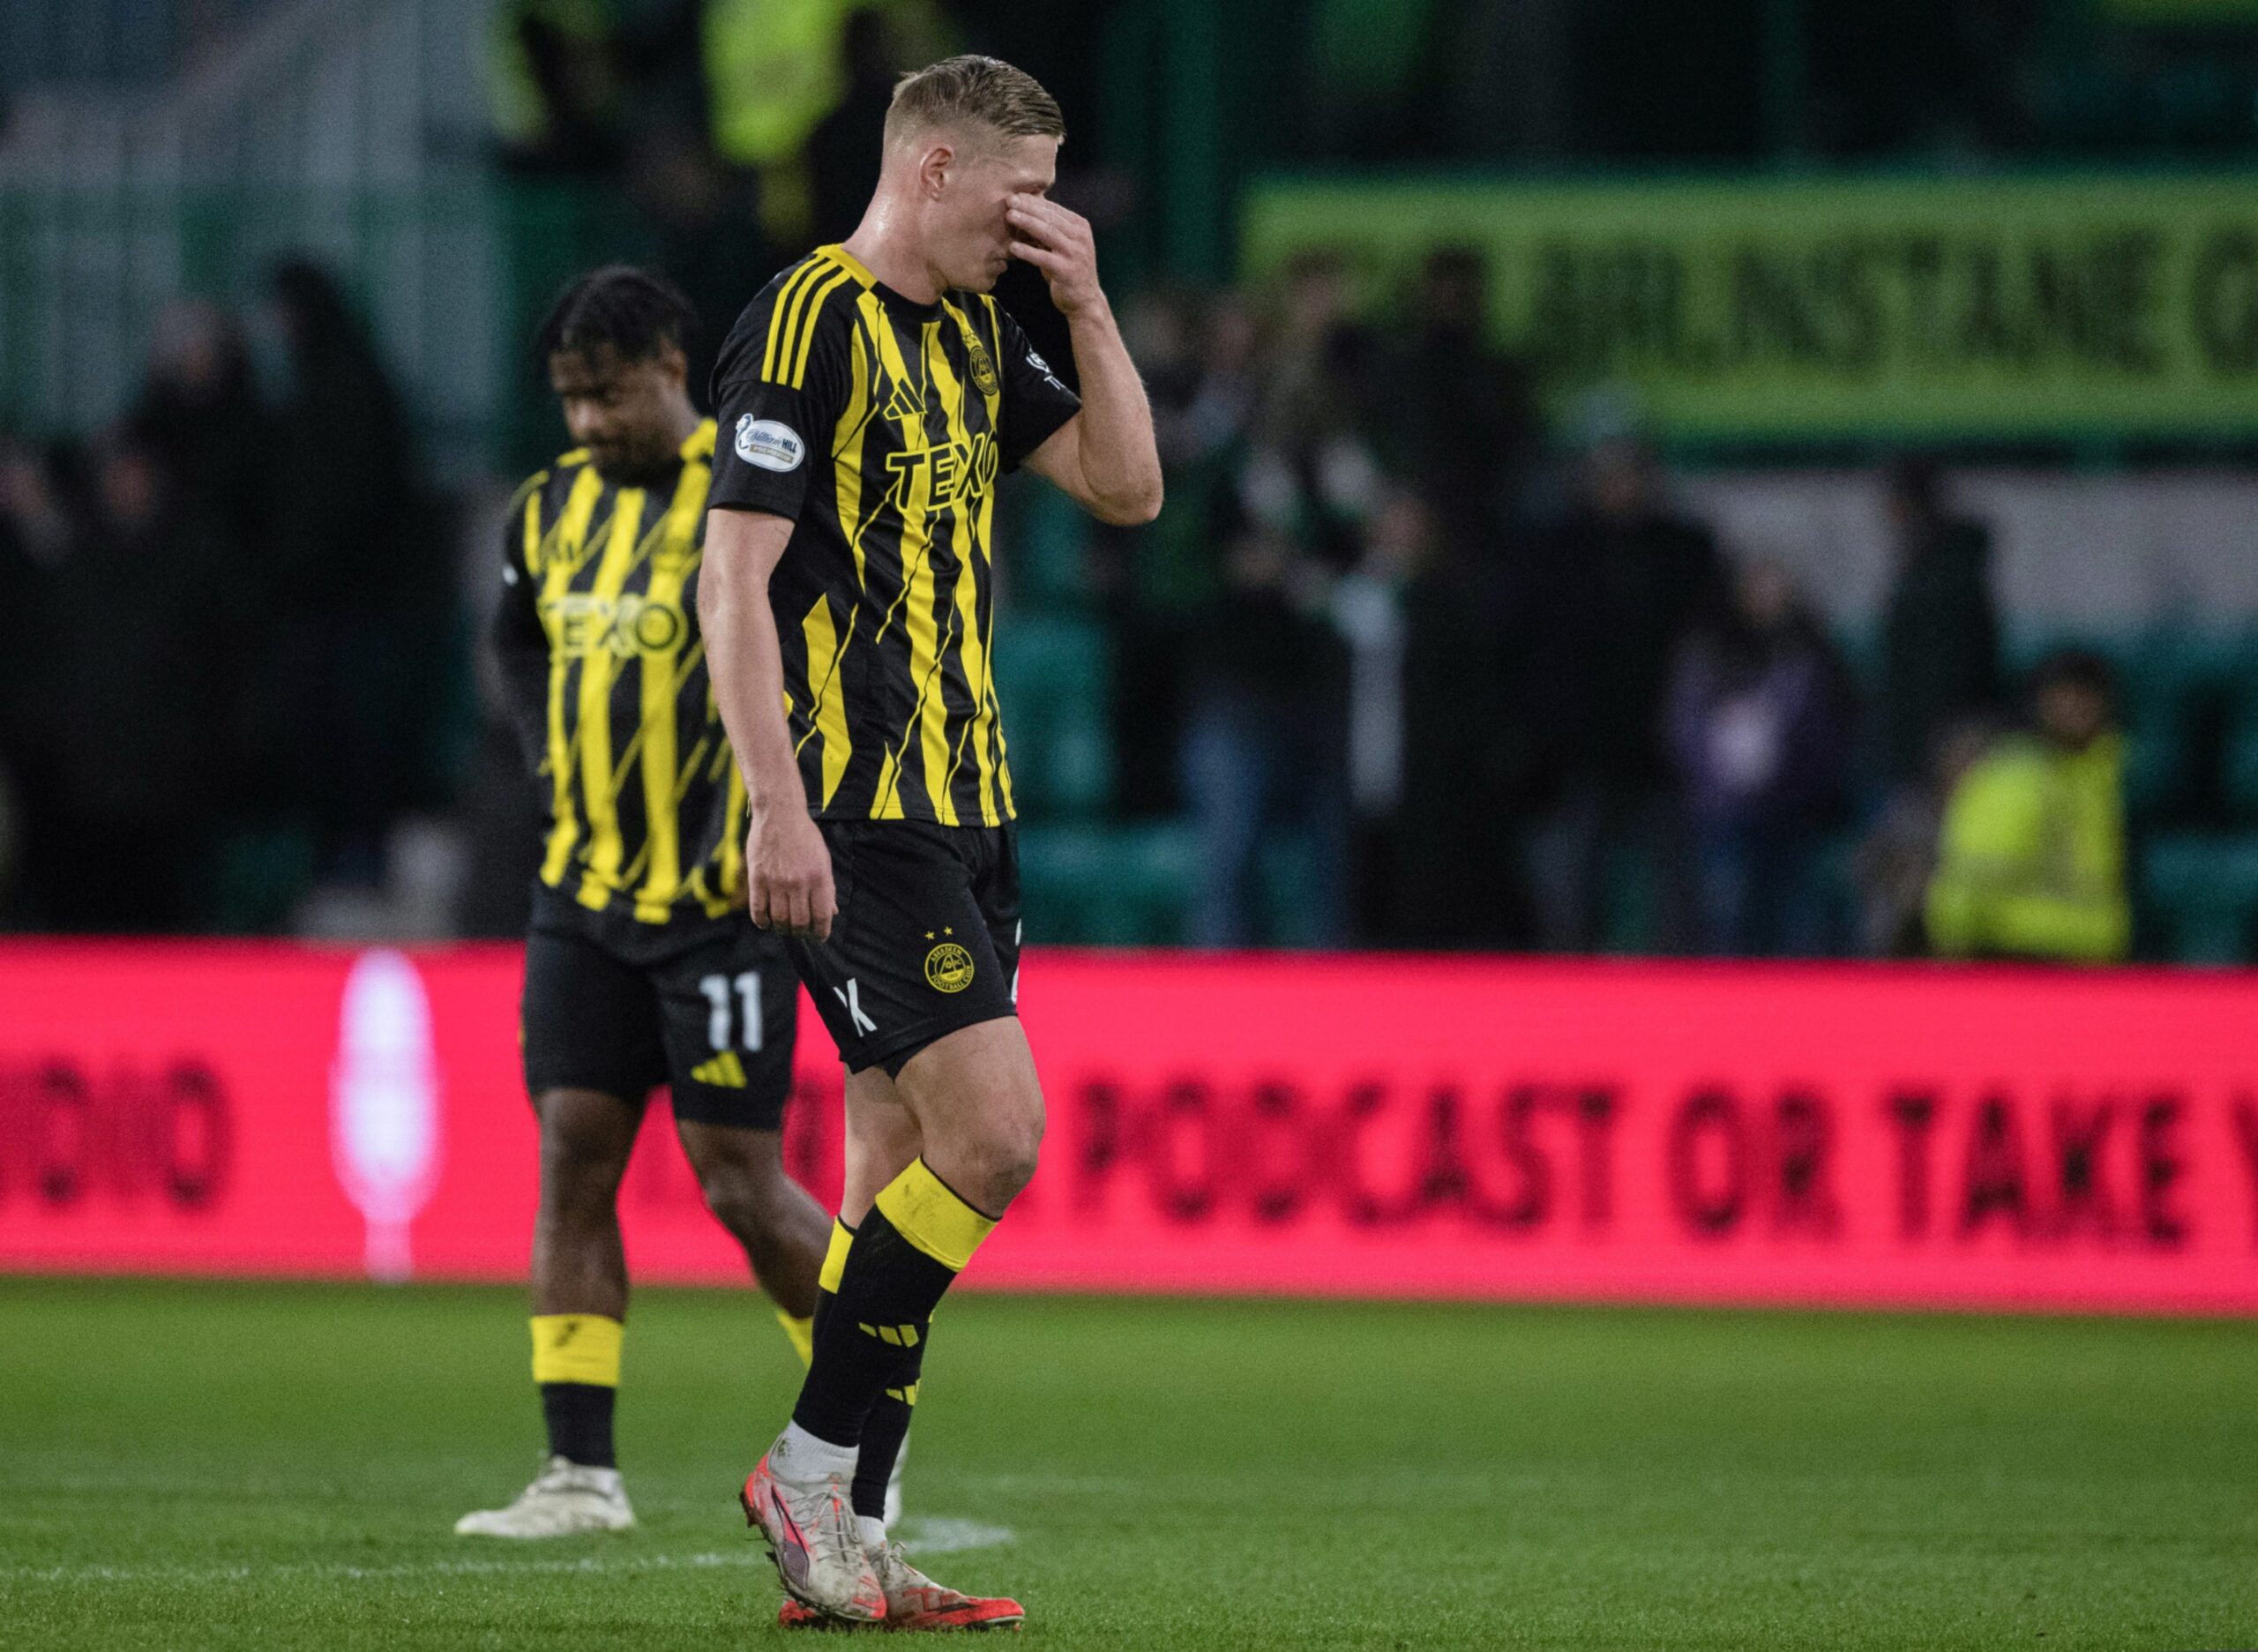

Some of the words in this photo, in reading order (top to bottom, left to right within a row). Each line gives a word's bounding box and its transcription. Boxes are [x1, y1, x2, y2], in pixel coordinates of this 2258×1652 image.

[781, 437, 797, 453] HILL
[886, 430, 998, 512] TEXO
[536, 594, 689, 660] TEXO
[931, 946, 962, 962] ABERDEEN
[931, 975, 965, 990] FOOTBALL
[699, 972, 763, 1051] 11
[1071, 1078, 1625, 1235] PODCAST
[1671, 1083, 1843, 1242] OR
[1879, 1083, 2189, 1251] TAKE
